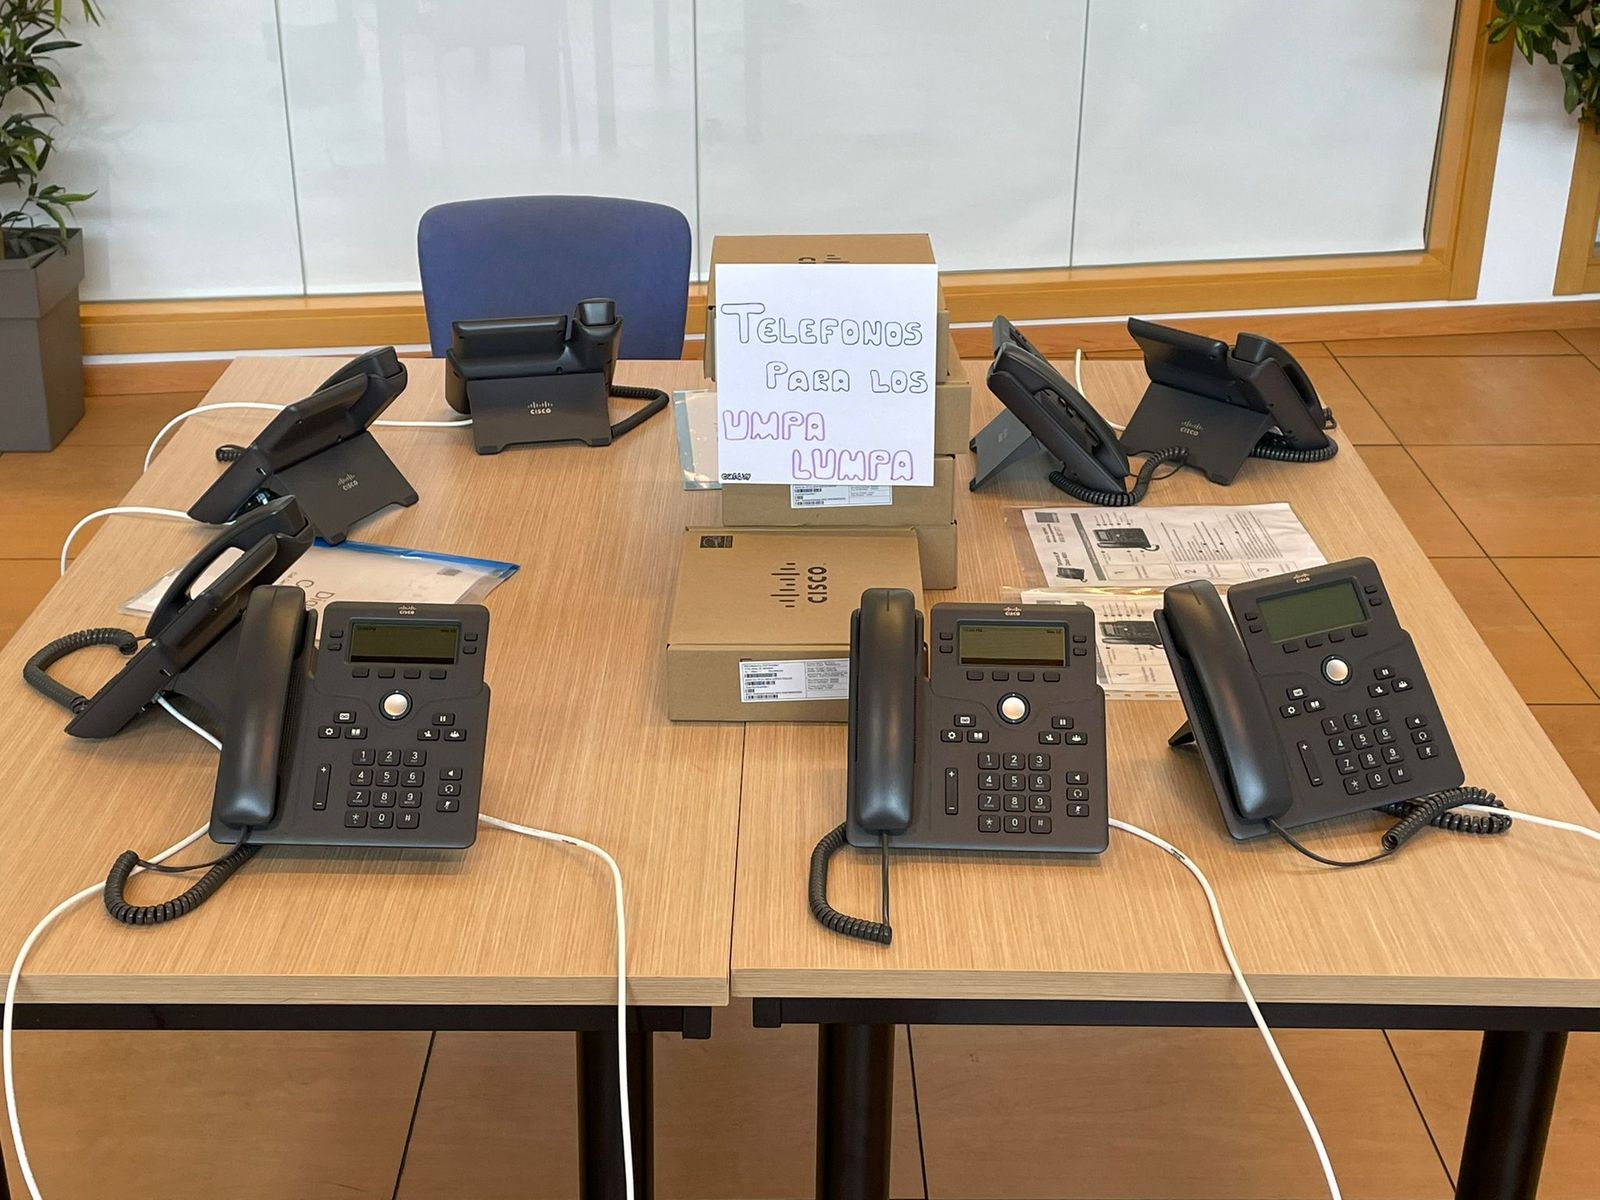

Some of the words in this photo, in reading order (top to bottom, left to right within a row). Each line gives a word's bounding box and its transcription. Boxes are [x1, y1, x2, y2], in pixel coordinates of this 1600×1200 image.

[720, 302, 923, 347] TELEFONOS
[765, 361, 850, 392] PARA
[870, 369, 929, 393] LOS
[530, 407, 552, 415] CISCO
[722, 410, 826, 441] UMPA
[792, 448, 914, 481] LUMPA
[807, 566, 828, 604] CISCO
[1374, 709, 1381, 717] 3
[1382, 728, 1388, 736] 6
[361, 750, 366, 758] 1
[386, 751, 392, 759] 2
[412, 752, 418, 760] 3
[1366, 754, 1374, 762] 8
[1390, 748, 1396, 756] 9
[1011, 755, 1018, 763] 2
[1036, 756, 1042, 764] 3
[358, 771, 364, 779] 4
[384, 772, 390, 780] 5
[410, 772, 416, 780] 6
[1374, 774, 1381, 782] 0
[1012, 776, 1018, 784] 5
[1036, 776, 1043, 784] 6
[356, 792, 362, 800] 7
[382, 792, 388, 800] 8
[1037, 798, 1044, 806] 9
[378, 814, 385, 822] 0
[1012, 818, 1018, 826] 0
